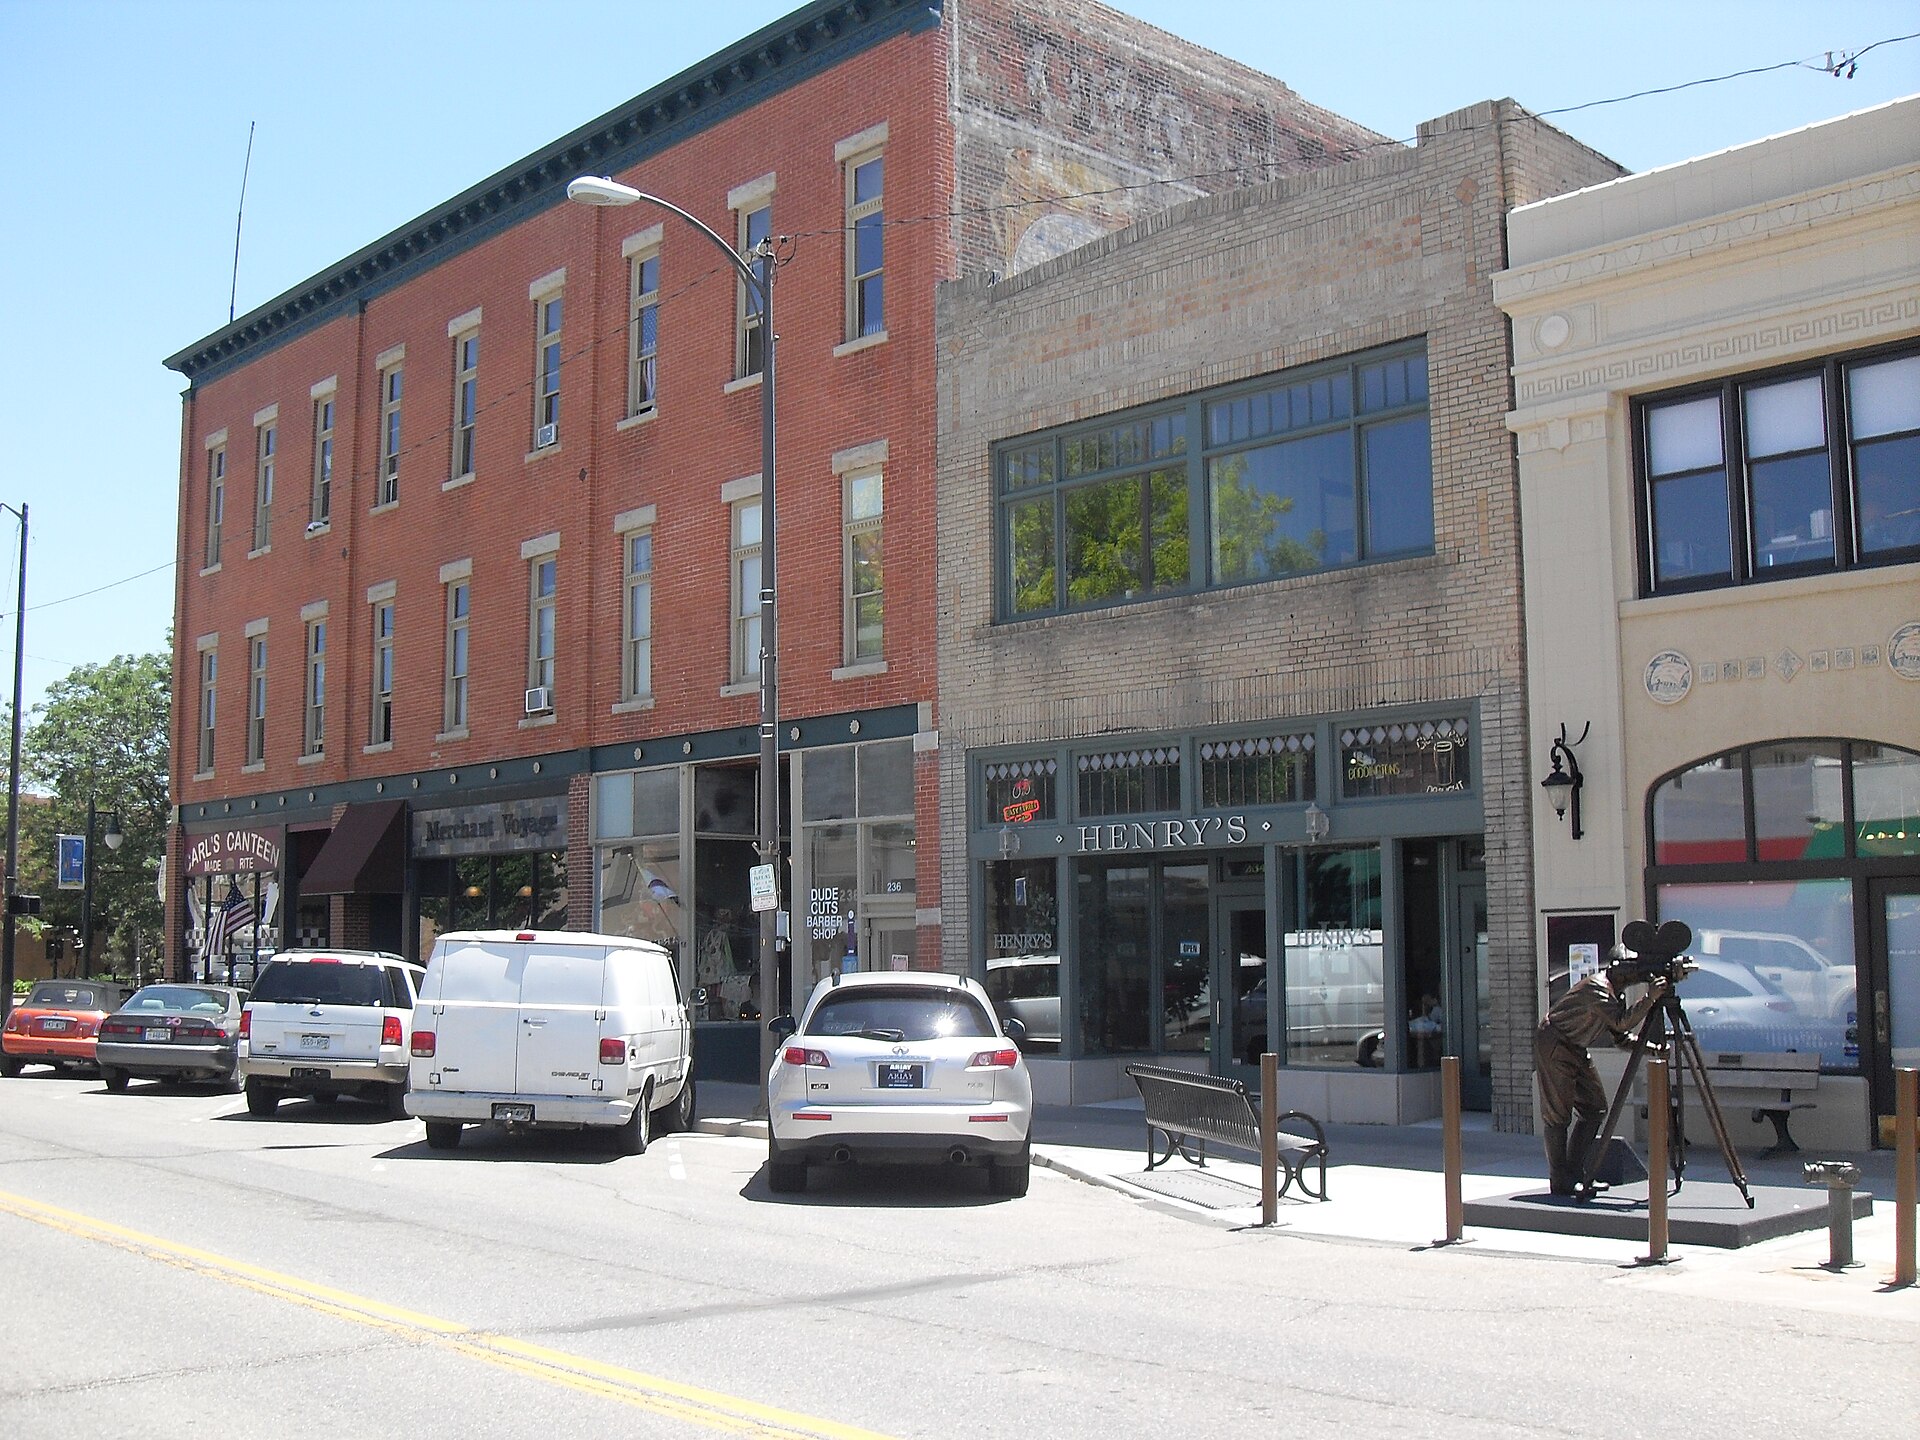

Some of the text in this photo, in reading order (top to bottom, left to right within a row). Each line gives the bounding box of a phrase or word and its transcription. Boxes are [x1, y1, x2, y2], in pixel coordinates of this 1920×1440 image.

[1077, 815, 1248, 852] HENRY'S
[226, 830, 280, 868] CANTEEN
[204, 857, 254, 872] MADE RITE
[811, 887, 839, 902] DUDE
[887, 882, 902, 892] 236
[811, 901, 838, 915] CUTS
[806, 915, 843, 928] BARBER
[812, 927, 837, 940] SHOP
[993, 932, 1053, 950] HENRY'S
[1295, 928, 1372, 945] HENRY'S
